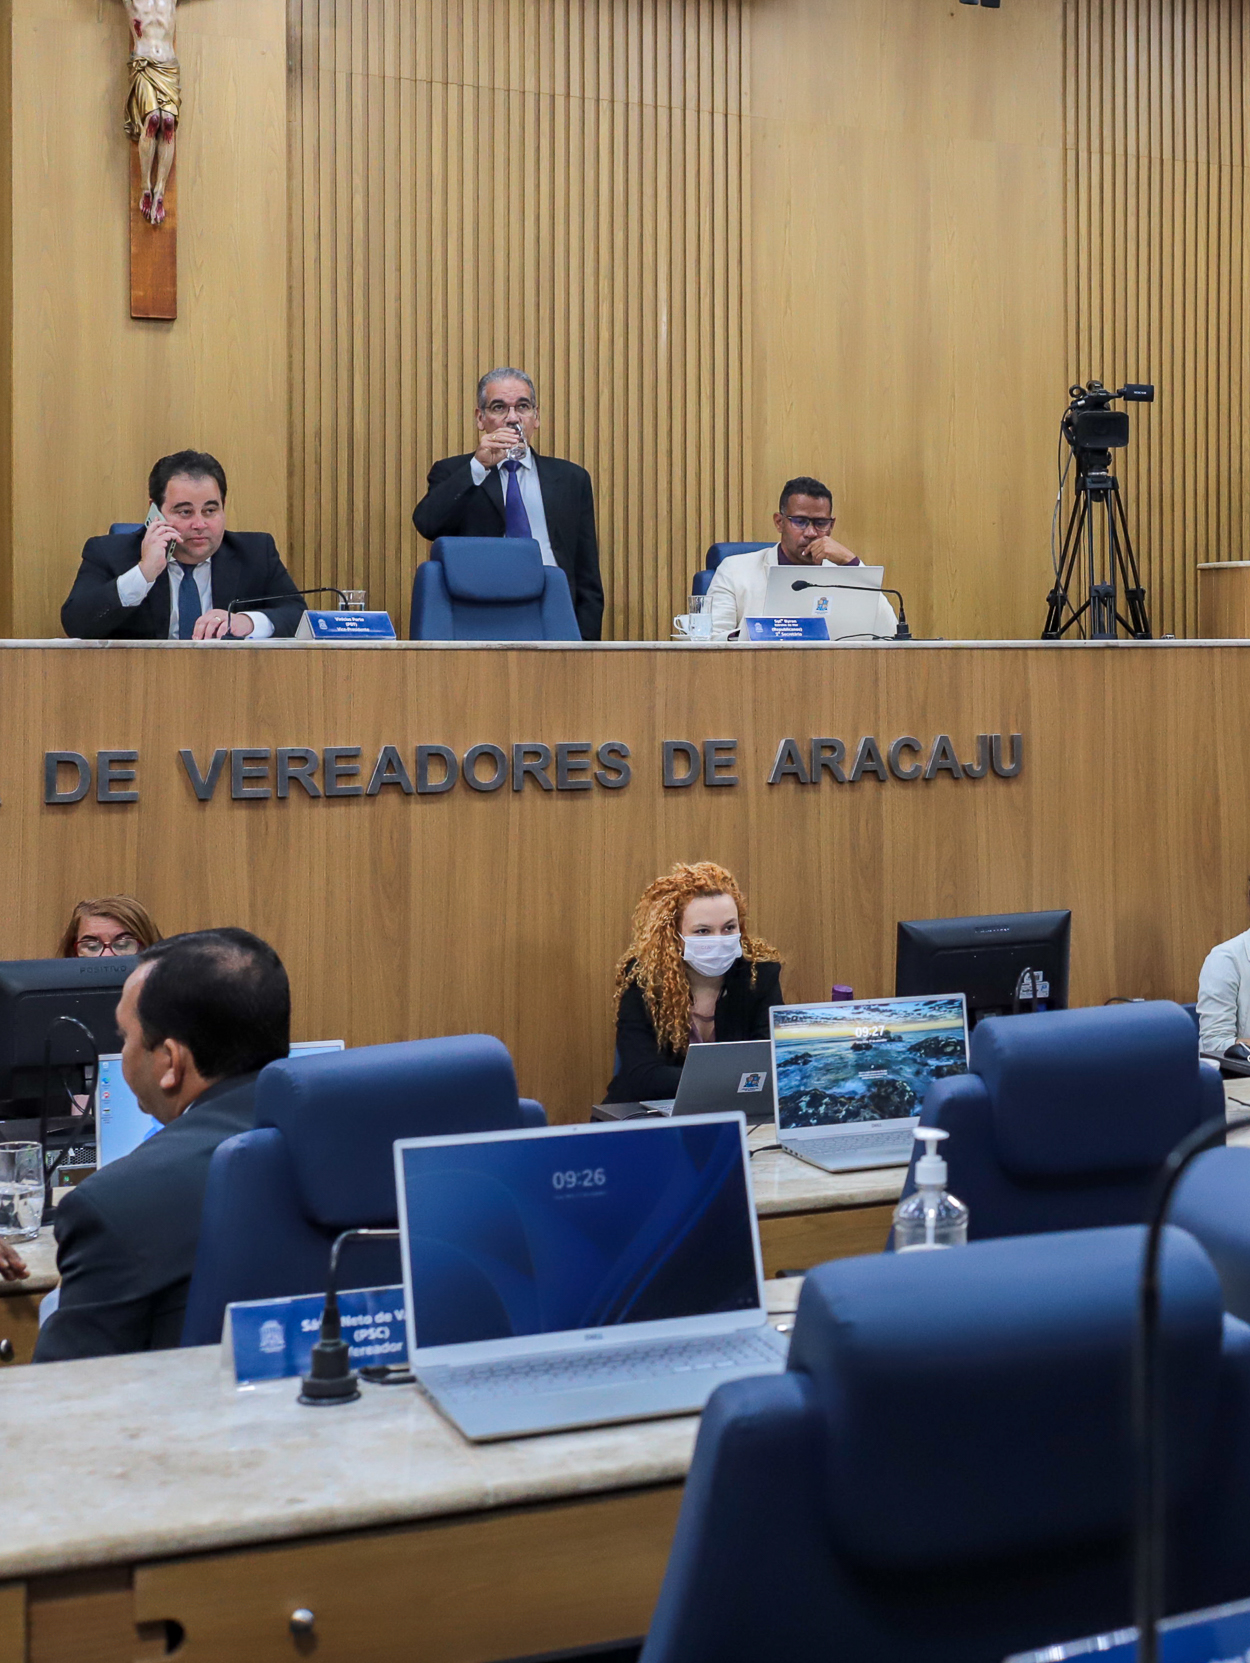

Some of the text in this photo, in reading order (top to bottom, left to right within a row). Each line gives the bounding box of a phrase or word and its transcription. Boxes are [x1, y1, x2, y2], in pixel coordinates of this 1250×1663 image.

[43, 733, 1023, 805] DE VEREADORES DE ARACAJU
[855, 1025, 886, 1038] 09:27
[552, 1167, 607, 1190] 09:26
[353, 1325, 390, 1343] (PSC)
